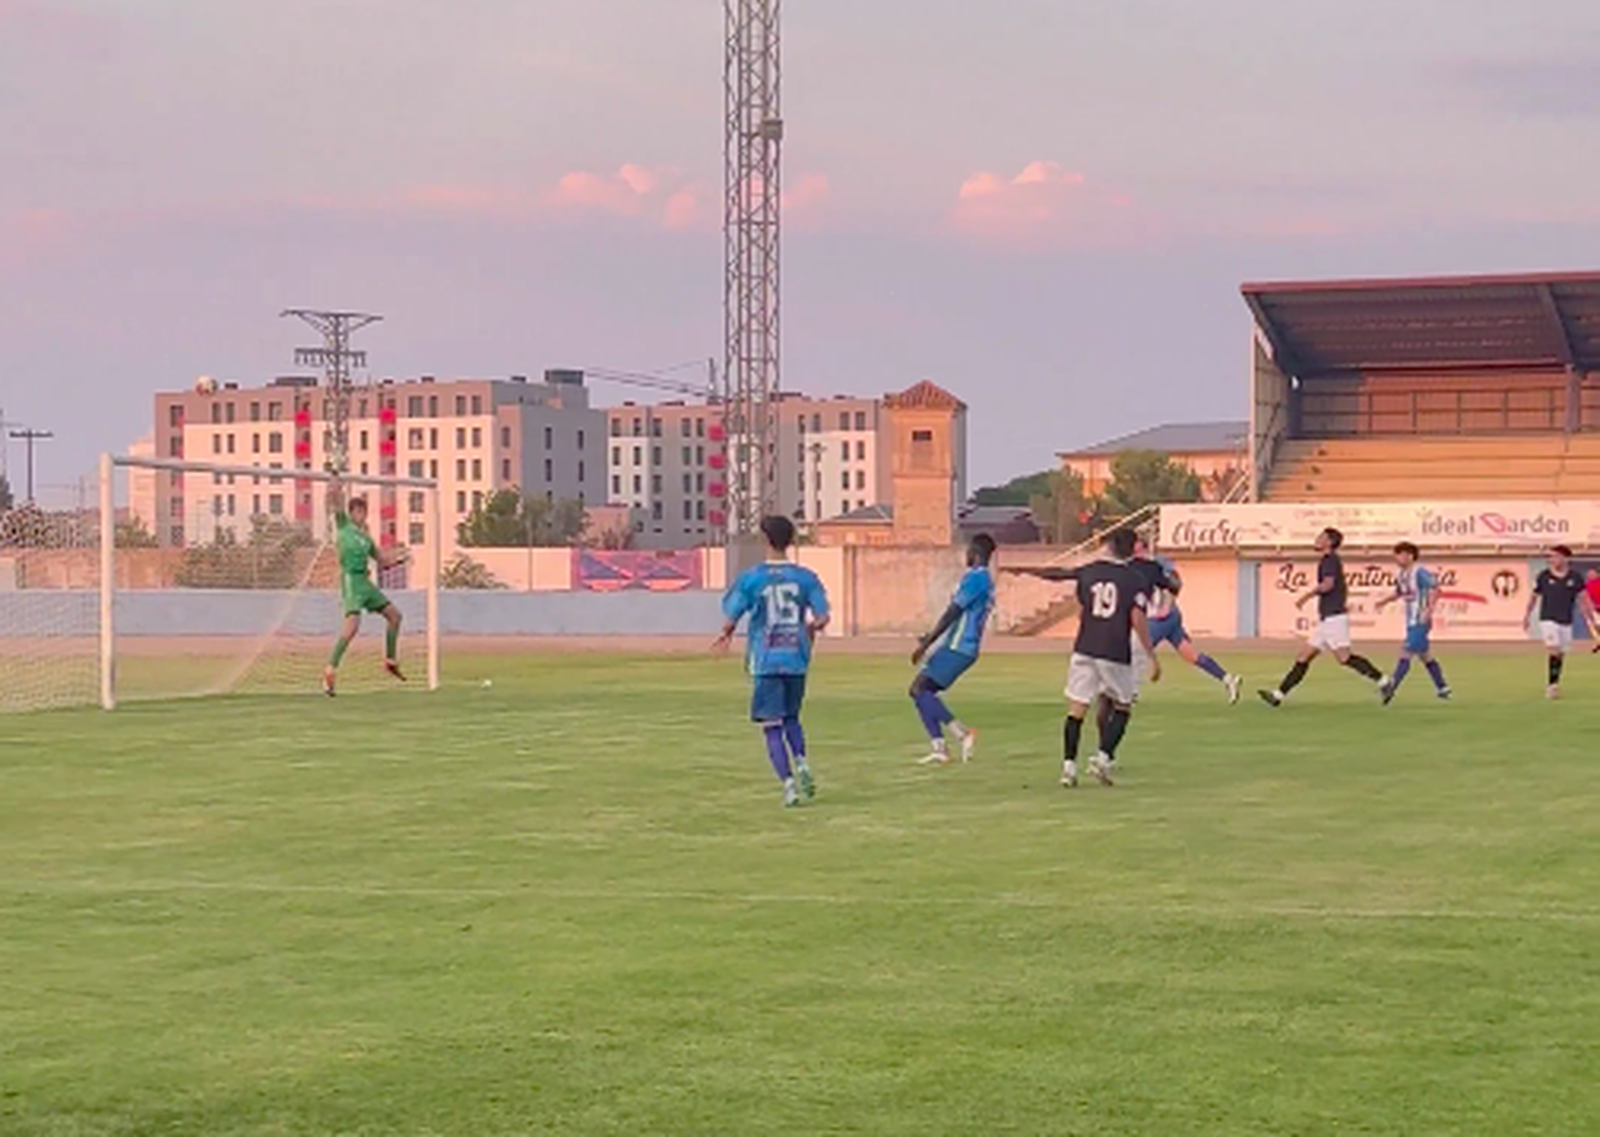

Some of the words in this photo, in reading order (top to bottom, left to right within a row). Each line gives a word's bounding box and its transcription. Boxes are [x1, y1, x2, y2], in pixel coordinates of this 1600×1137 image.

[1421, 513, 1475, 534] ideal
[1275, 563, 1308, 592] La
[762, 582, 800, 625] 15
[1090, 581, 1117, 619] 19
